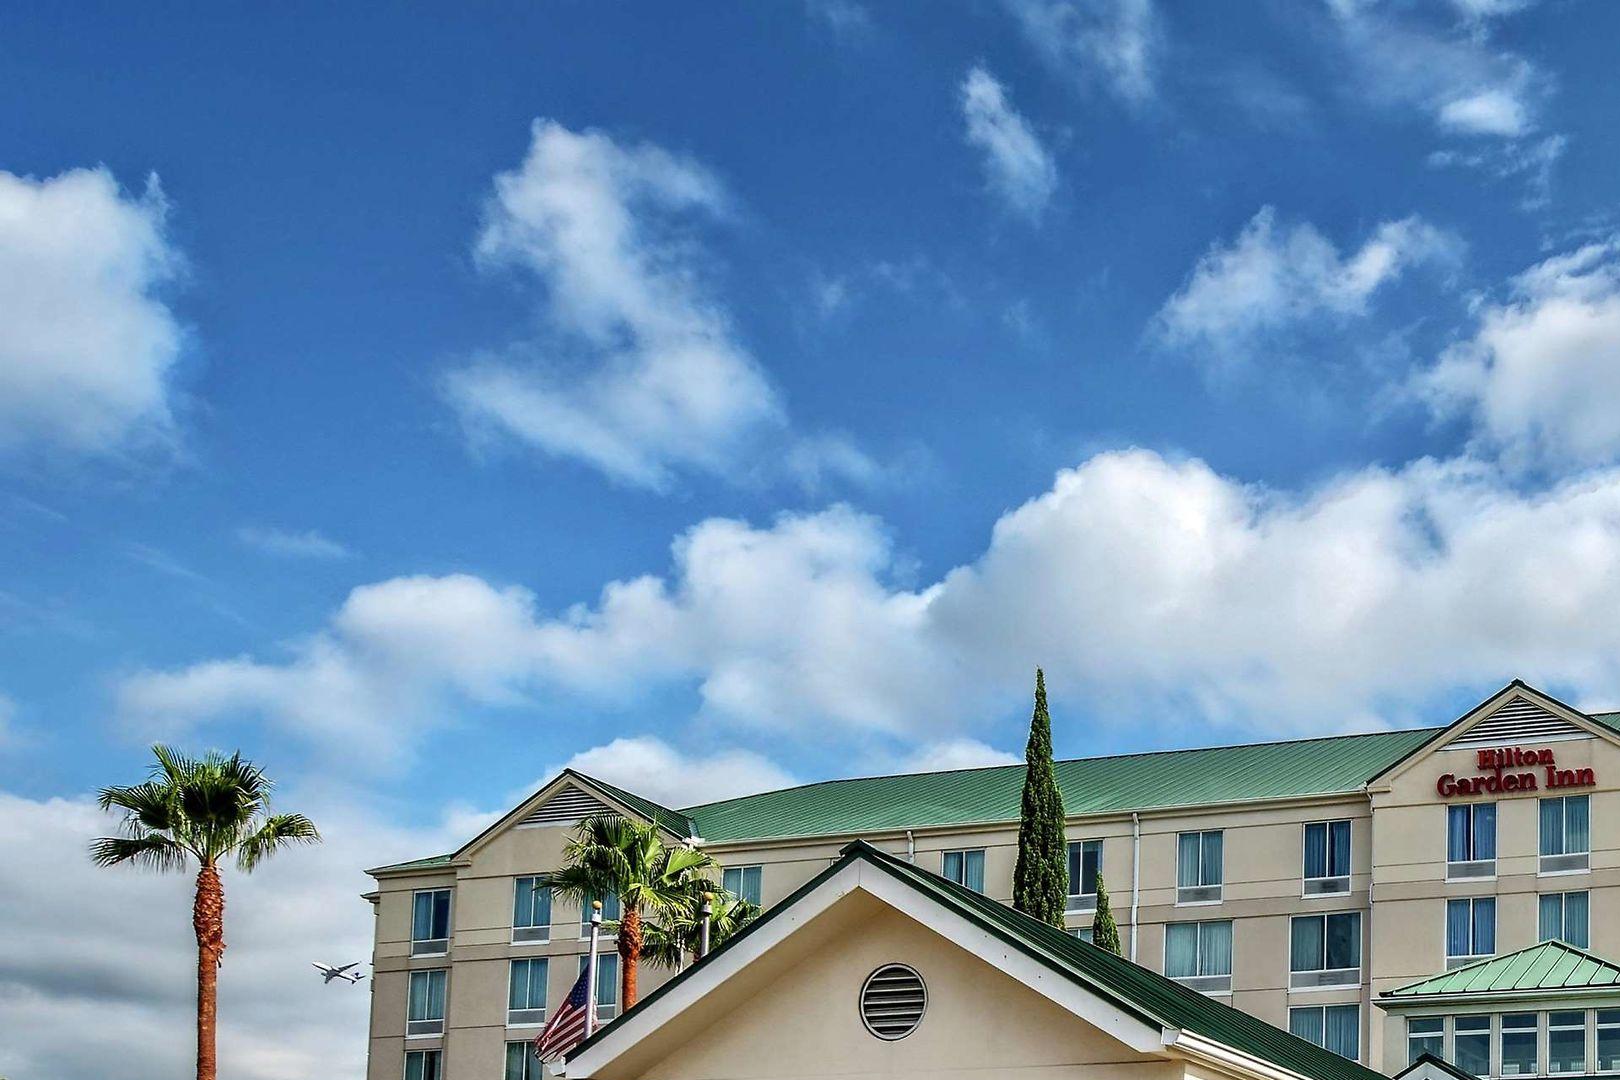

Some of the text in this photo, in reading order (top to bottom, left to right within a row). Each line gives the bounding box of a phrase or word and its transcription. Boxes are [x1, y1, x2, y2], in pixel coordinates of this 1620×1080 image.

[1477, 747, 1555, 770] Hilton
[1437, 766, 1596, 797] Garden Inn
